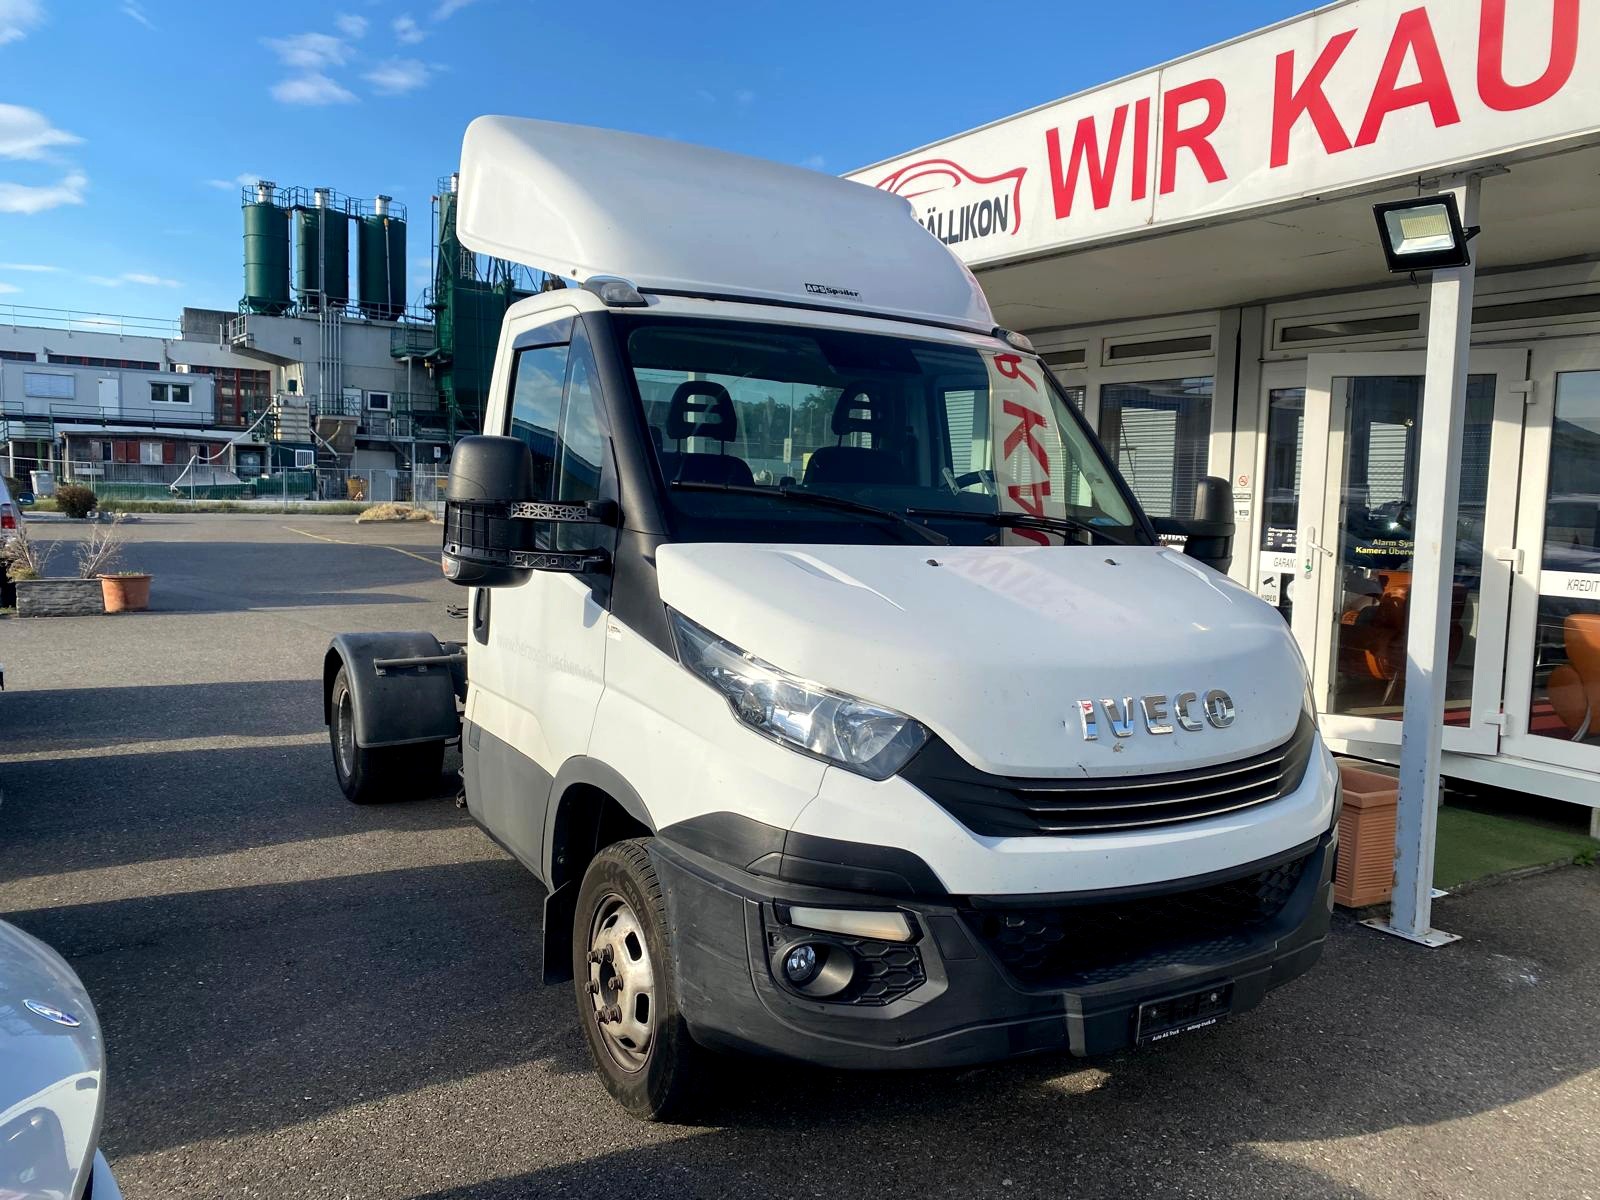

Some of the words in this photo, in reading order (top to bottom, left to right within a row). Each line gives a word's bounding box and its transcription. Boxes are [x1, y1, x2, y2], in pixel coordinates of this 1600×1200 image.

[1046, 78, 1228, 219] WIR
[1270, 0, 1580, 168] KAU
[918, 194, 1009, 246] ÄLLIKON
[1355, 546, 1387, 555] Kamera
[1371, 538, 1397, 547] Alarm
[1075, 688, 1237, 742] IVECO
